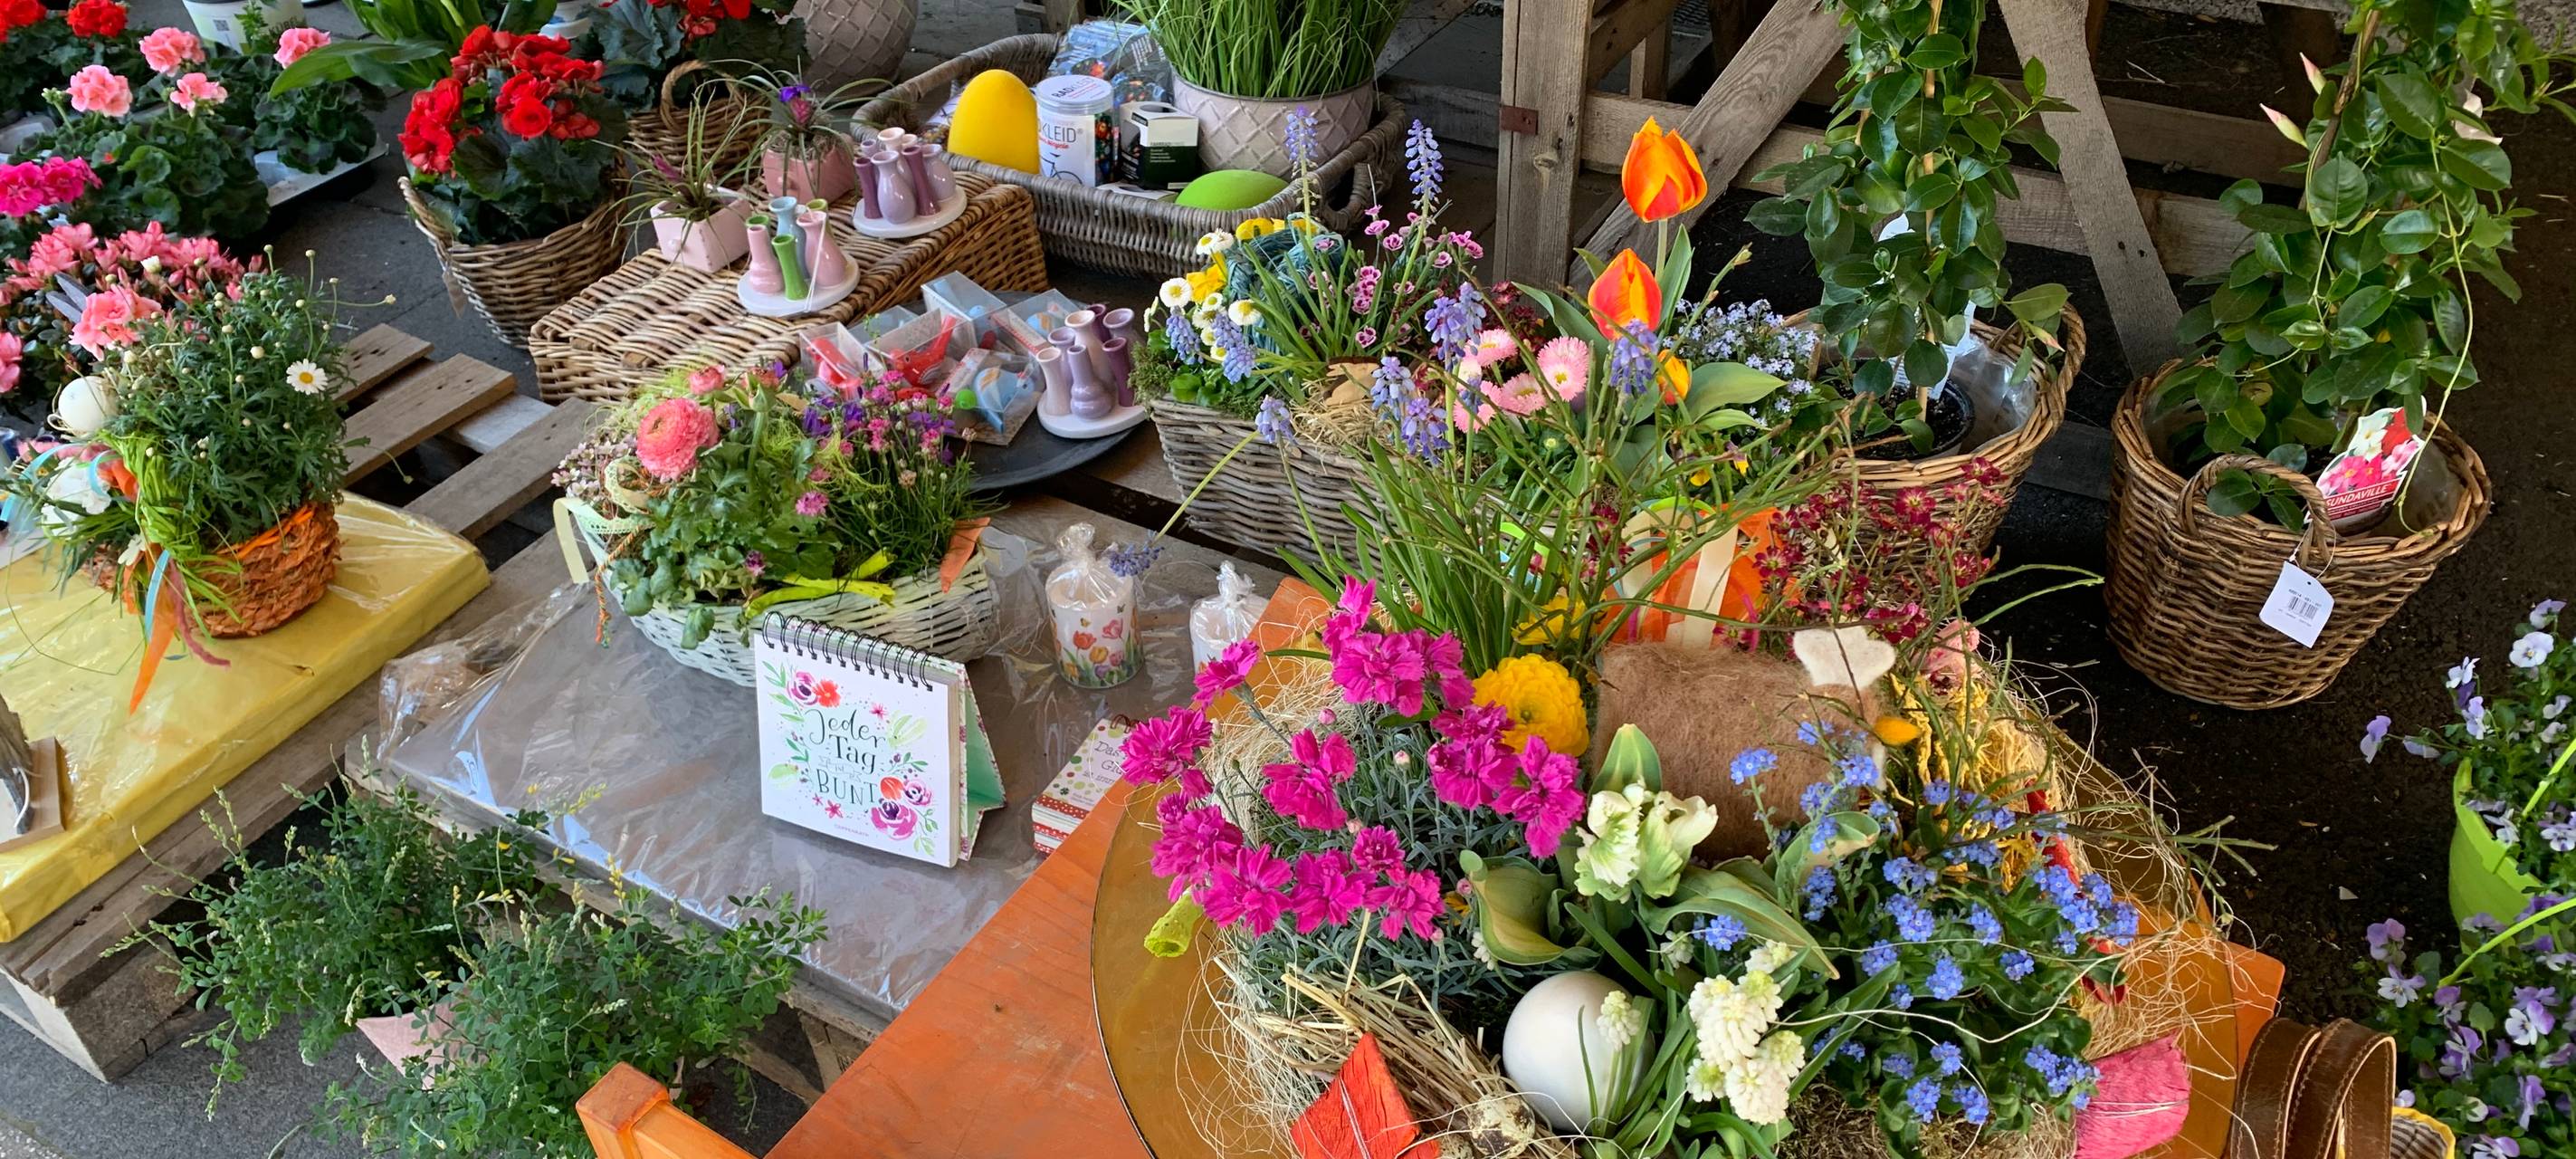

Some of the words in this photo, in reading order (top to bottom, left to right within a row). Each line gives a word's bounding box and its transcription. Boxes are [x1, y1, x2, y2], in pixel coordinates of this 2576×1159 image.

[2325, 484, 2388, 507] SUNDAVILLE
[804, 708, 886, 749] Jeder
[828, 733, 876, 774] Tag
[1093, 741, 1121, 757] Das
[816, 768, 878, 806] BUNT
